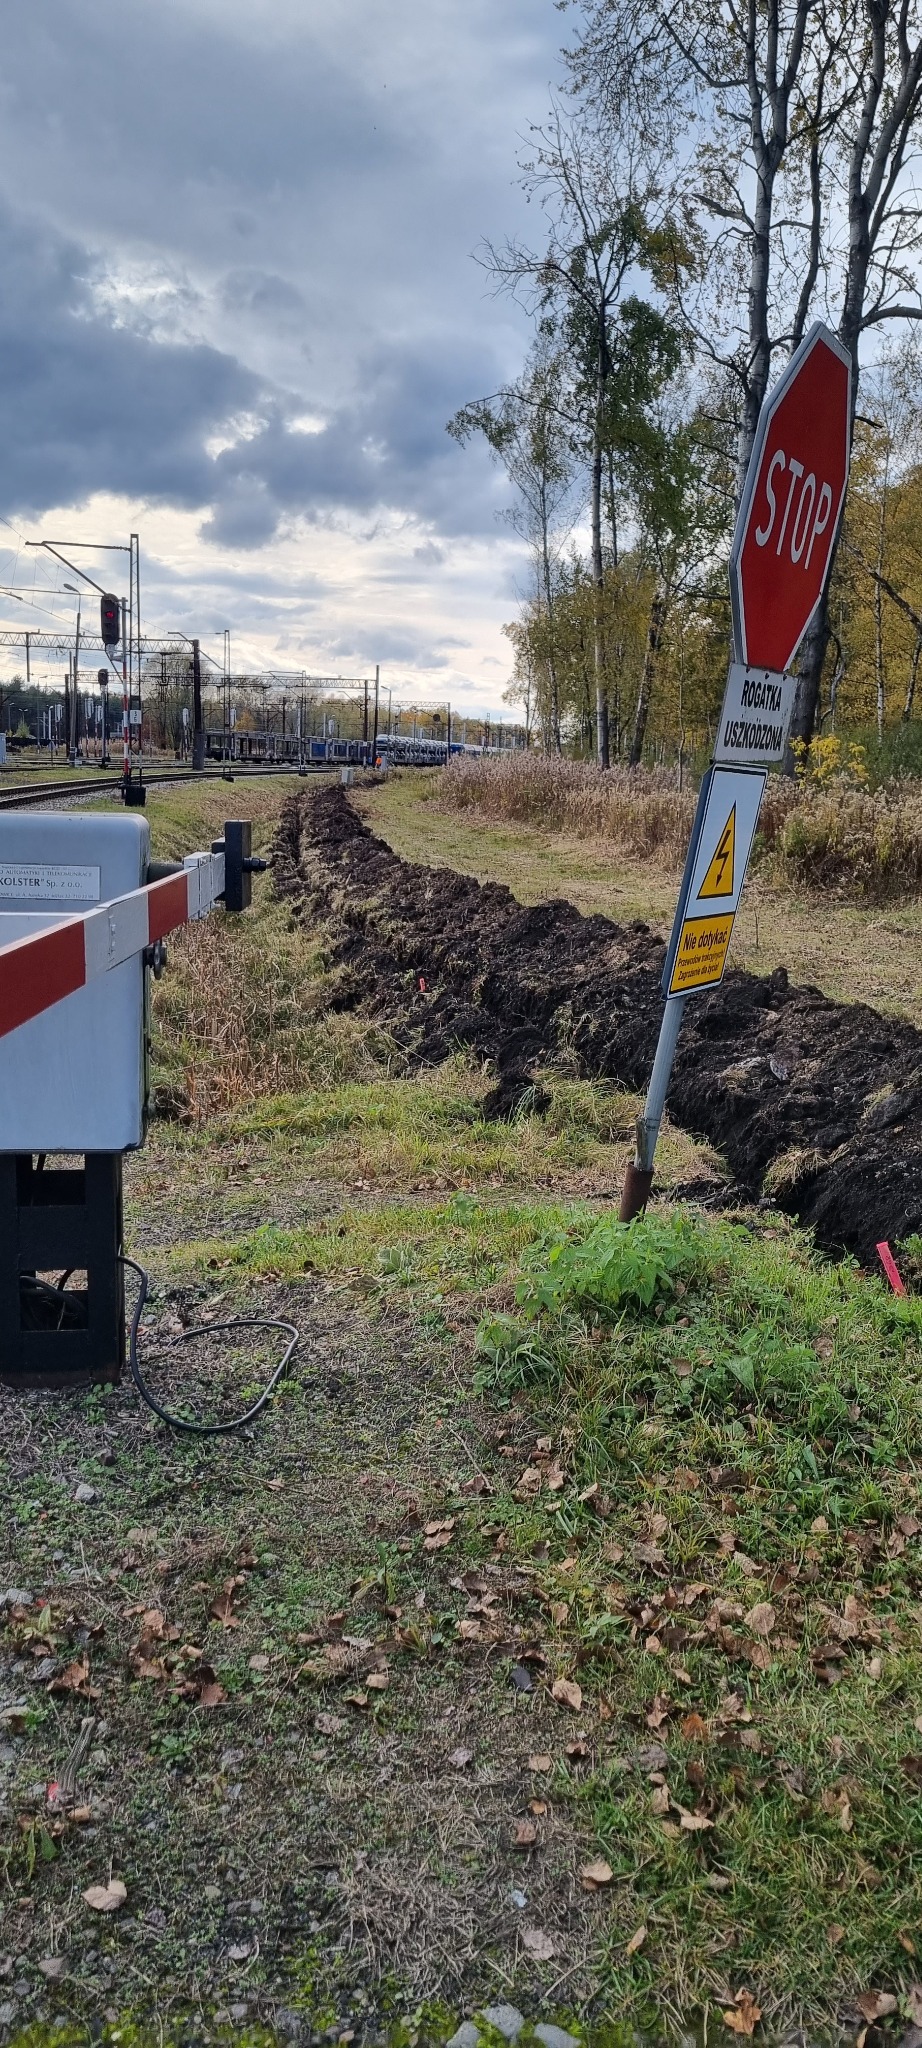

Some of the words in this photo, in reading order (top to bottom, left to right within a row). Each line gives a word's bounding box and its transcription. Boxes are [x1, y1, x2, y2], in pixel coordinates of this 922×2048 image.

[755, 449, 833, 570] STOP
[740, 679, 782, 711] ROGATKA
[723, 720, 783, 751] USZKODZONA
[46, 880, 58, 889] Sp.
[683, 932, 697, 951] Nie
[698, 926, 729, 950] dotykać
